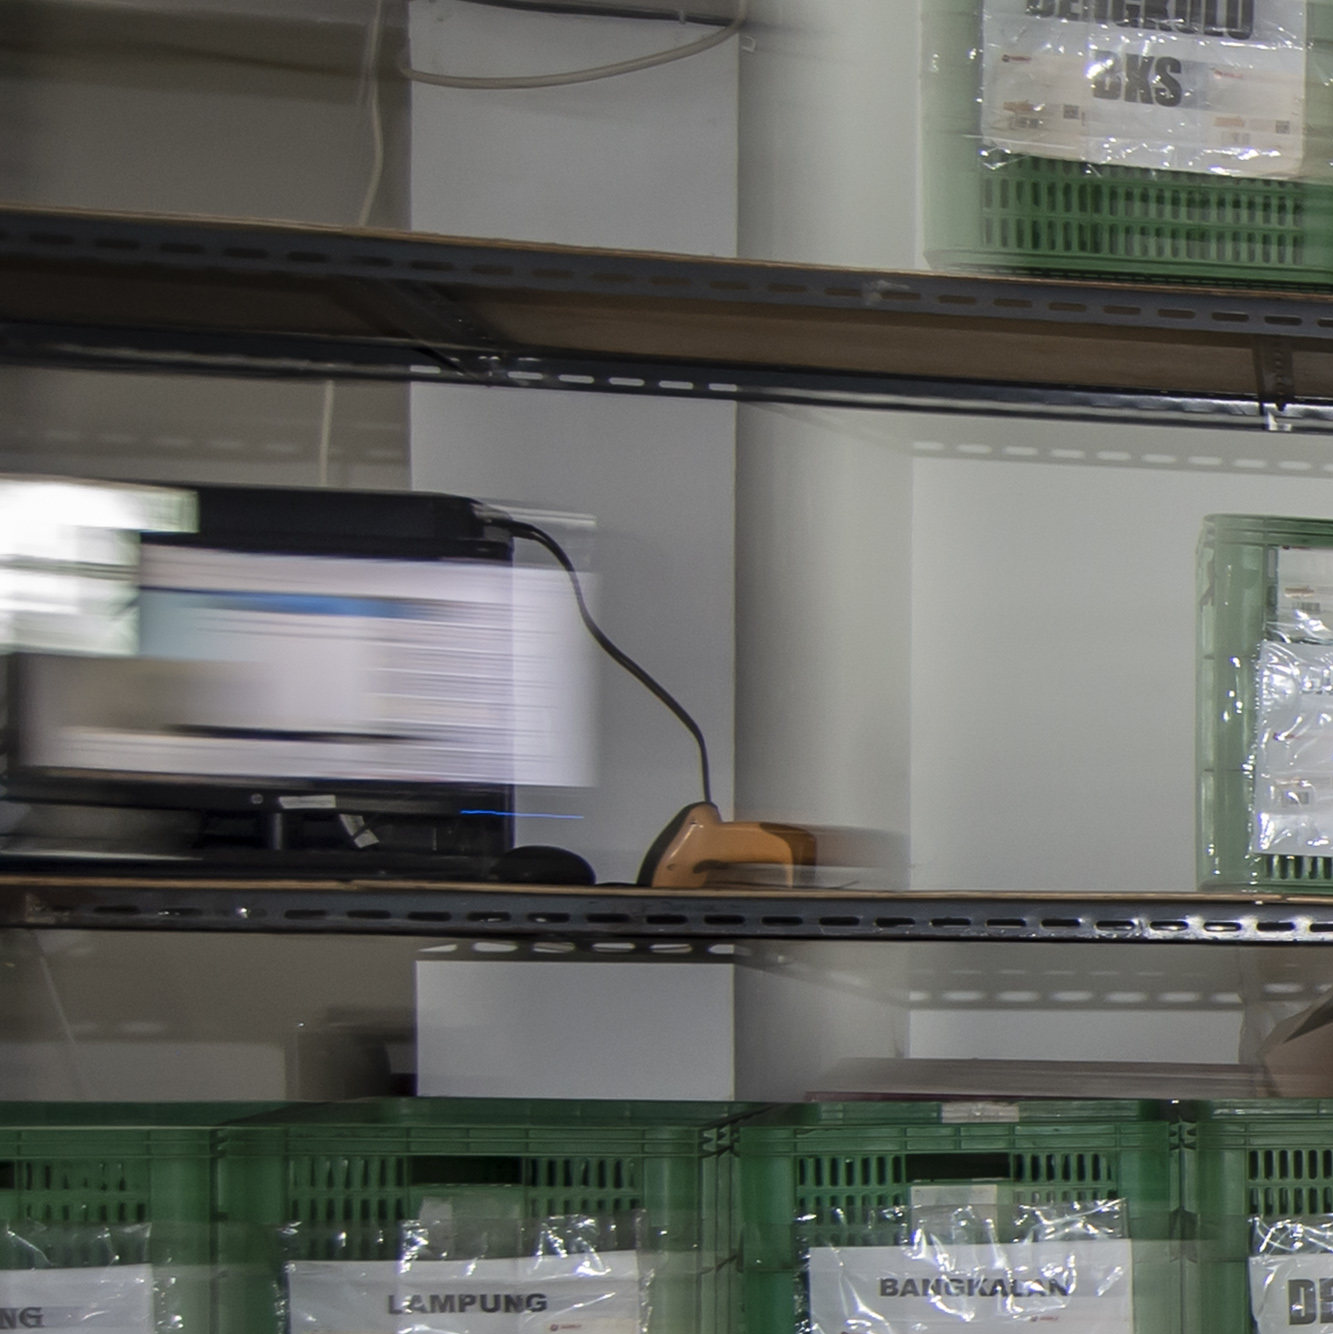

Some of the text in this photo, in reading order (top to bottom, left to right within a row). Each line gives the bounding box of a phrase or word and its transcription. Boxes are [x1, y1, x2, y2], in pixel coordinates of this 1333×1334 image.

[1093, 51, 1182, 107] BKS
[879, 1277, 1069, 1299] BANGKALAN
[387, 1292, 548, 1315] LAMPUNG
[0, 1307, 45, 1331] NG
